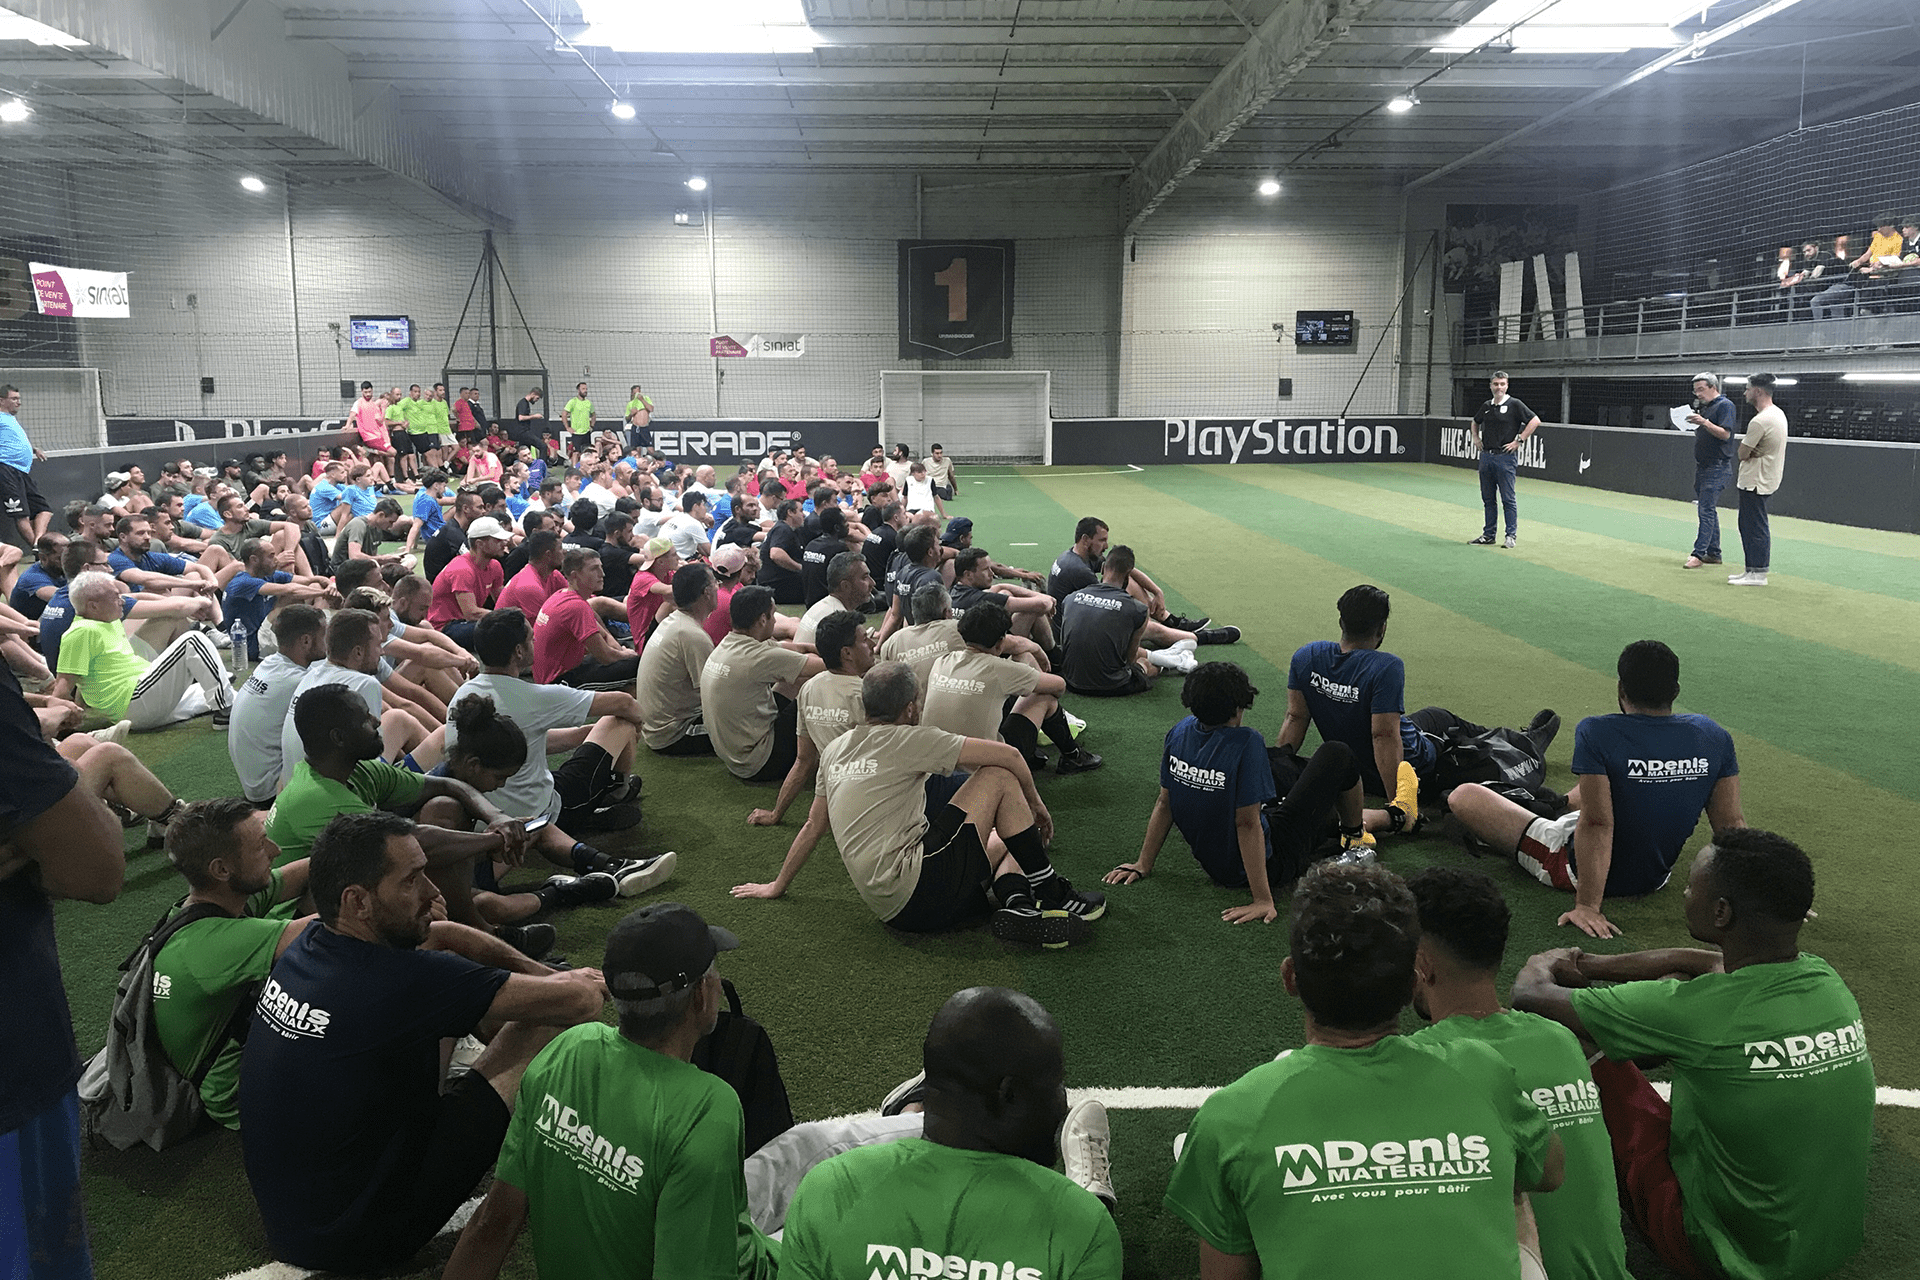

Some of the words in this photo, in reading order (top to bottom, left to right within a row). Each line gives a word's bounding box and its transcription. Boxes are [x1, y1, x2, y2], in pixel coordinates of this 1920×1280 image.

[934, 257, 967, 321] 1
[763, 340, 801, 352] siniat
[907, 640, 948, 656] Denis
[941, 674, 985, 690] Denis
[1322, 677, 1359, 695] Denis
[813, 706, 849, 718] Denis
[1178, 760, 1226, 781] Denis
[1648, 757, 1709, 771] Denis
[1648, 768, 1709, 777] MATERIAUX
[1176, 770, 1225, 787] MATERIAUX
[265, 979, 331, 1026] Denis
[261, 995, 327, 1035] MATERIAUX
[1809, 1066, 1829, 1076] vous
[1833, 1060, 1853, 1071] pour
[1522, 1078, 1599, 1107] enis
[1552, 1120, 1575, 1130] pour
[557, 1105, 645, 1178] Denis
[1323, 1132, 1490, 1168] Denis
[554, 1126, 640, 1190] MATERIAUX
[1327, 1159, 1491, 1183] MATERIAUX
[1311, 1192, 1345, 1203] Avec
[1352, 1189, 1387, 1198] vous
[1394, 1186, 1430, 1198] pour
[1438, 1184, 1471, 1194] Bâtir
